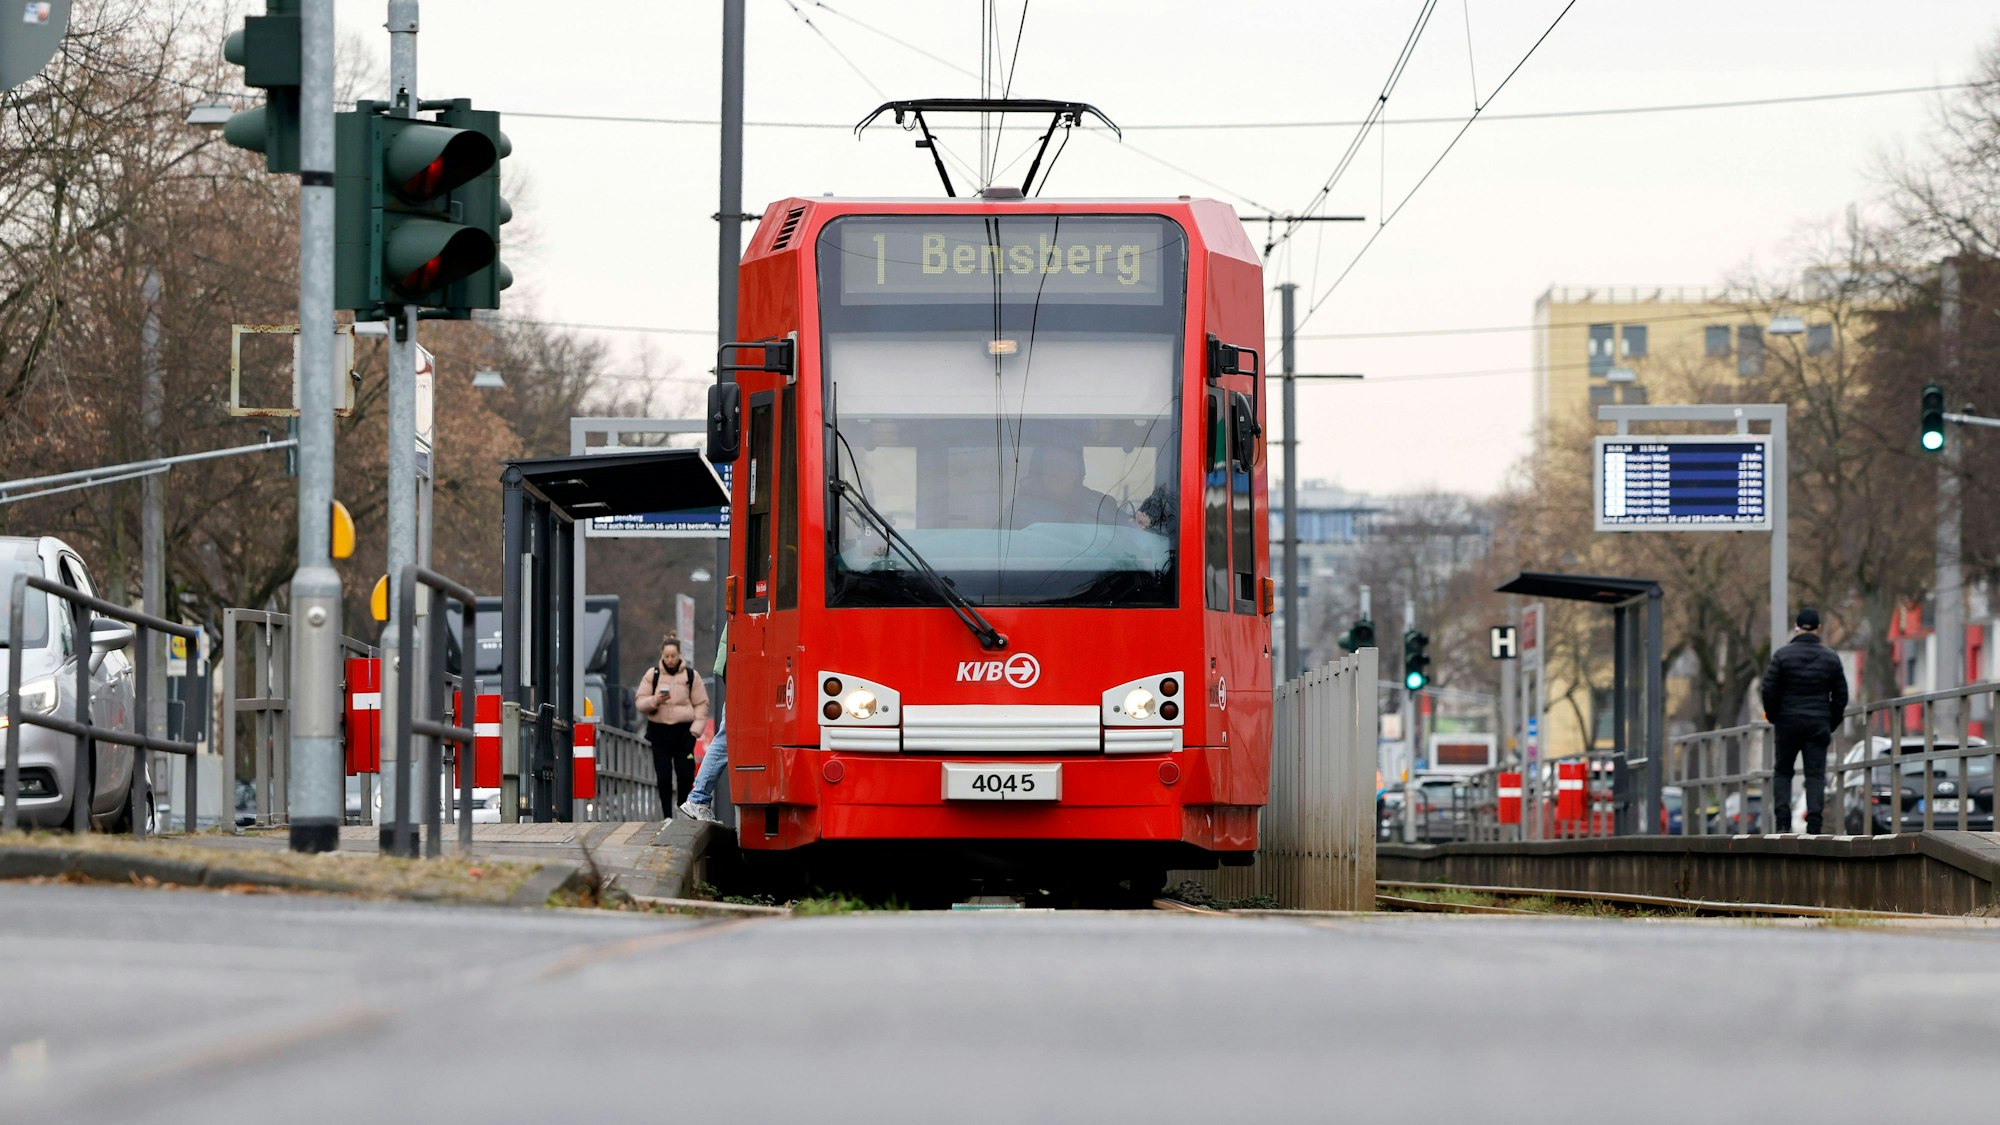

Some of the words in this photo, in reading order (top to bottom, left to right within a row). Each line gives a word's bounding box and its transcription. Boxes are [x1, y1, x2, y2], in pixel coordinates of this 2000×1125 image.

[873, 234, 885, 285] 1
[922, 234, 1140, 285] Bensberg
[1652, 454, 1670, 462] West
[1748, 453, 1762, 461] Min
[1652, 463, 1670, 471] West
[1748, 462, 1762, 470] Min
[1652, 471, 1670, 480] West
[1748, 470, 1762, 479] Min
[1652, 480, 1670, 488] West
[1748, 479, 1762, 487] Min
[1652, 489, 1670, 497] West
[1748, 488, 1762, 496] Min
[1652, 497, 1670, 506] West
[1748, 496, 1762, 505] Min
[1652, 506, 1670, 515] West
[1748, 505, 1762, 514] Min
[1646, 515, 1667, 523] Linien
[1677, 515, 1691, 523] und
[594, 522, 607, 530] sind
[608, 522, 624, 530] auch
[624, 522, 635, 530] die
[635, 522, 655, 530] Linien
[656, 522, 664, 530] 16
[664, 522, 677, 530] und
[1491, 628, 1516, 657] H
[955, 661, 1004, 682] KVB
[972, 773, 1035, 792] 4045
